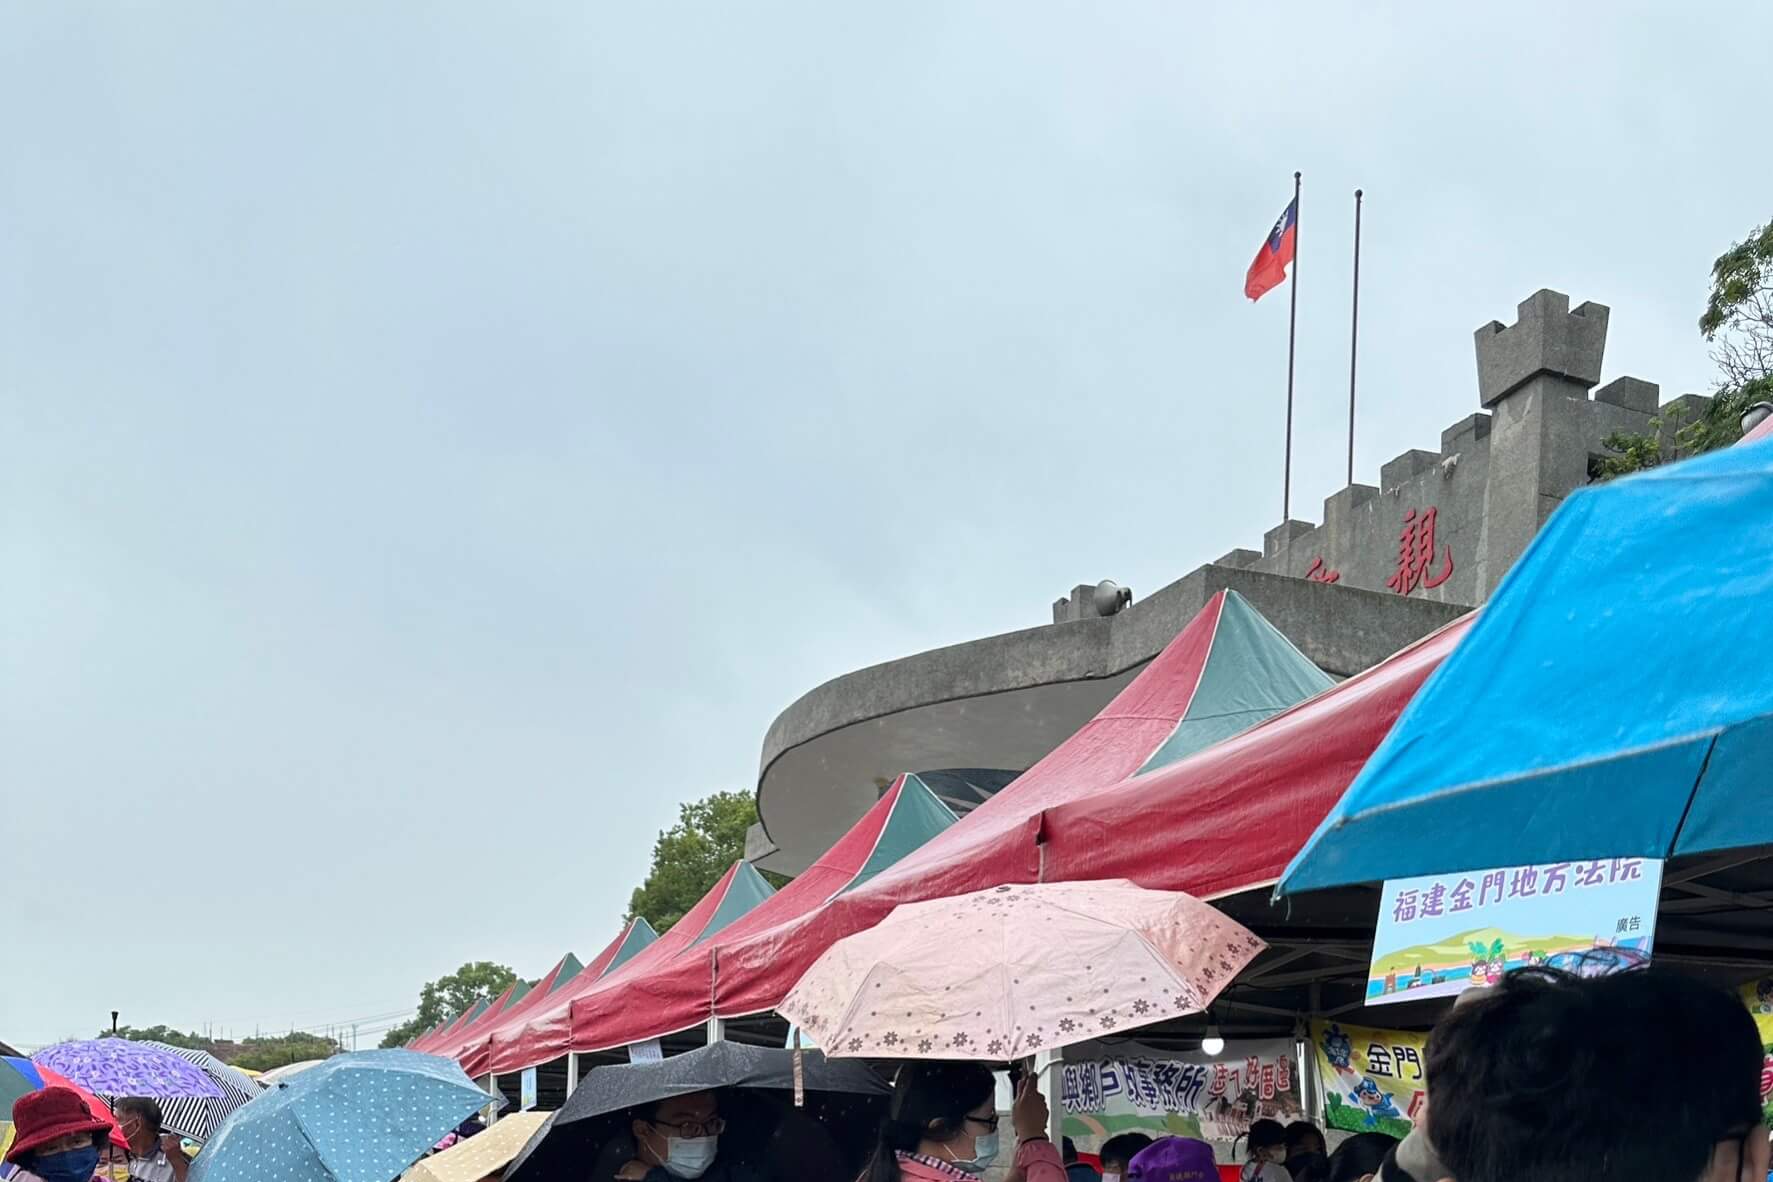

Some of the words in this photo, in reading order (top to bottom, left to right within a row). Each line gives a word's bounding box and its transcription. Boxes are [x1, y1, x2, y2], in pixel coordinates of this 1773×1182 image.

[1386, 505, 1454, 597] 親
[1393, 858, 1642, 923] 福建金門地方法院
[1615, 916, 1641, 934] 廣告
[1365, 1042, 1426, 1081] 金門
